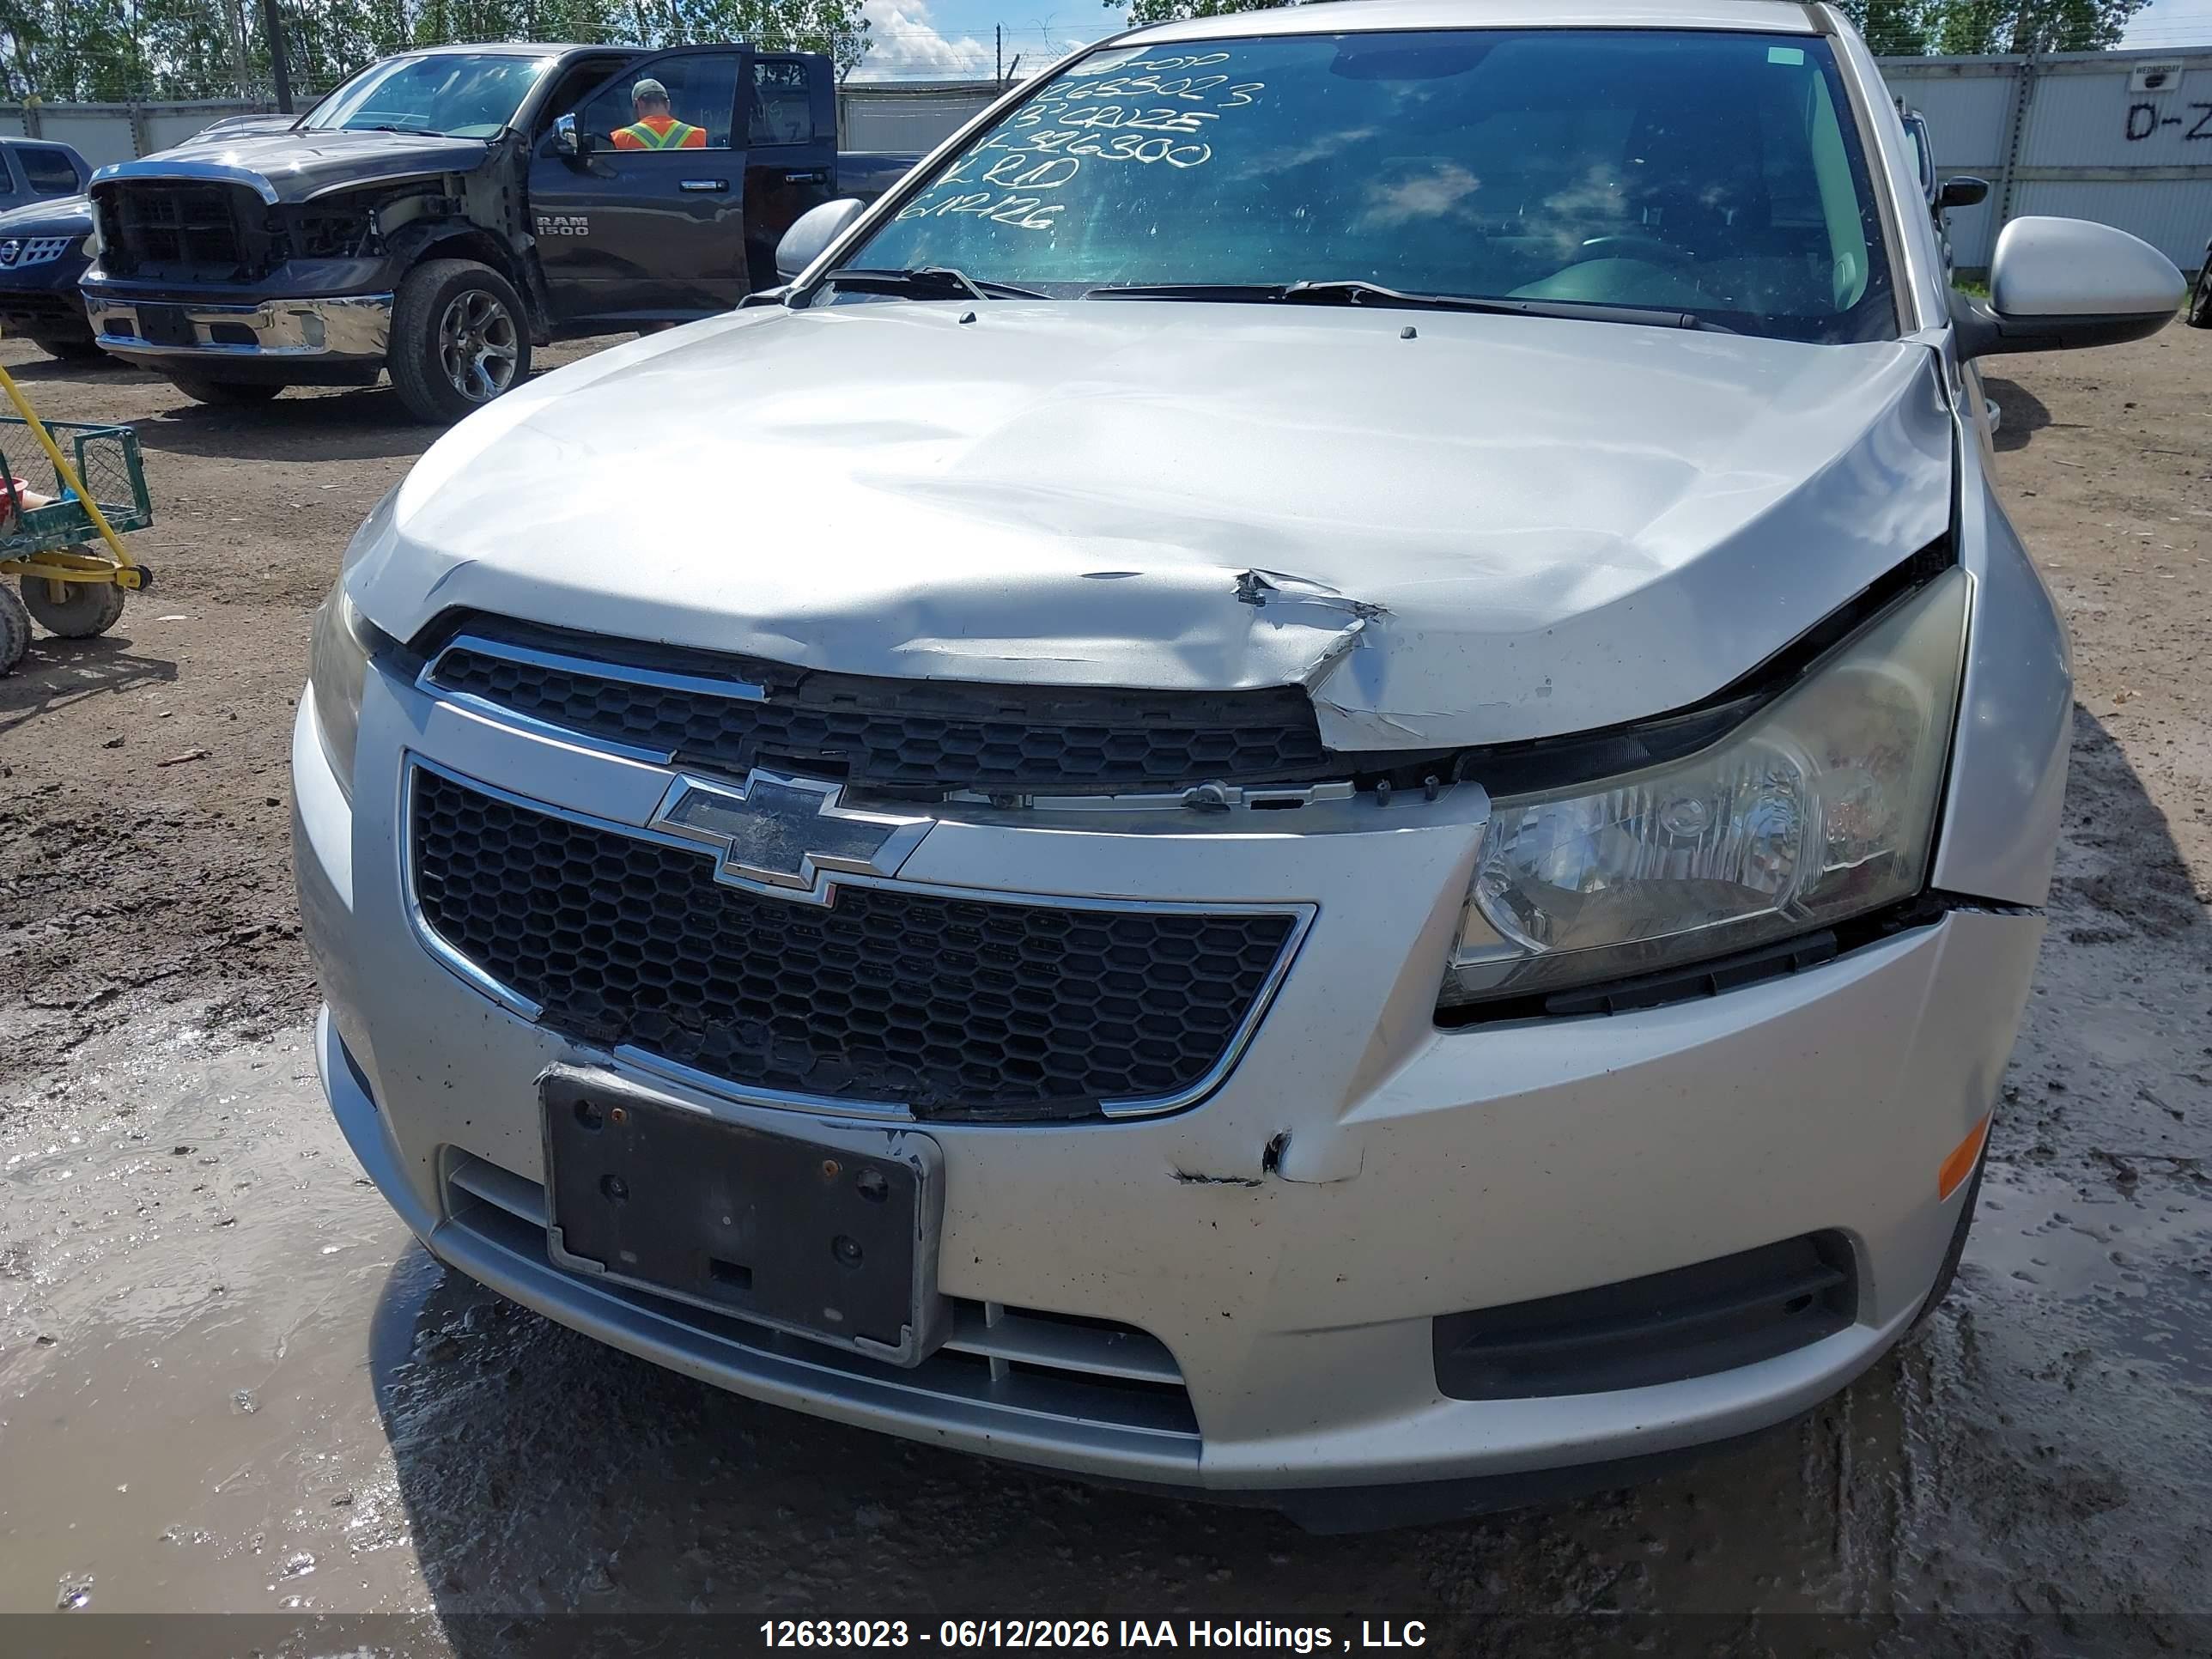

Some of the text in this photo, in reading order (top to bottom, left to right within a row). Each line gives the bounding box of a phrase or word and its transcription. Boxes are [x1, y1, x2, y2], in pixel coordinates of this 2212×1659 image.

[2136, 64, 2181, 74] WEDNESDAY
[536, 216, 589, 226] RAM
[538, 226, 590, 236] 1500
